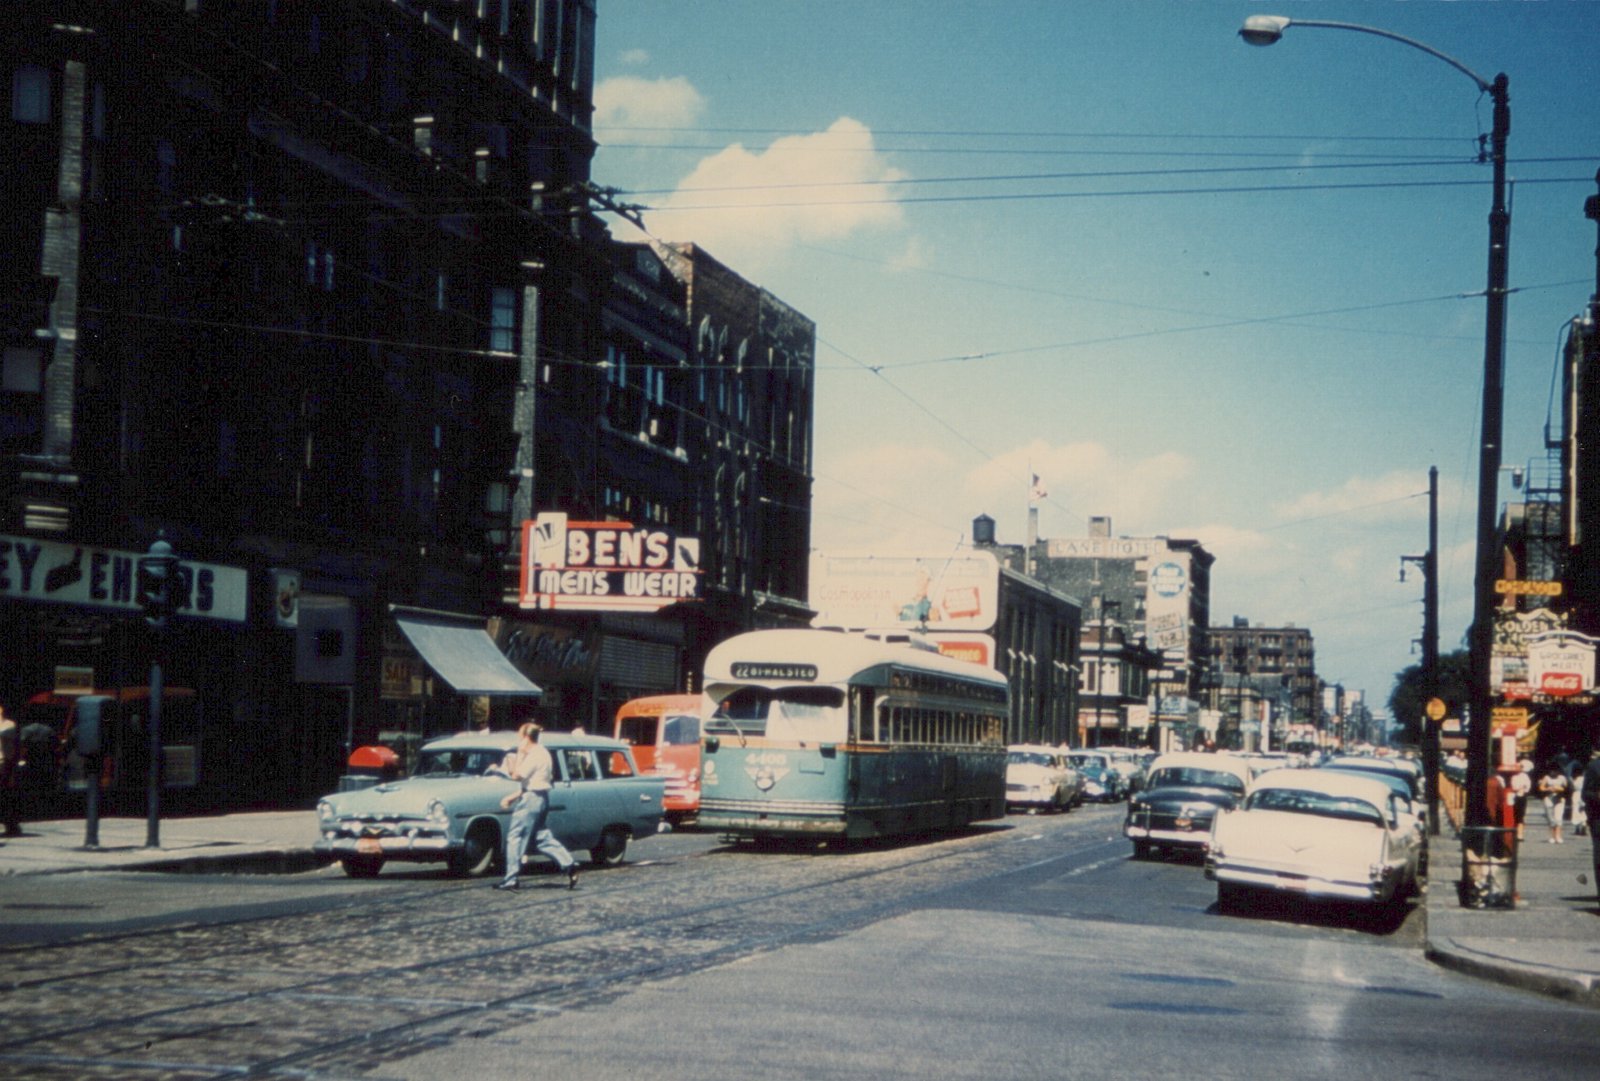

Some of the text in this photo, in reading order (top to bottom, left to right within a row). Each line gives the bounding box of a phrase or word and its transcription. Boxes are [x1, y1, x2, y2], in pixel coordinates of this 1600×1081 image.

[567, 529, 669, 567] BEN'S
[539, 569, 697, 598] MEN'S WEAR
